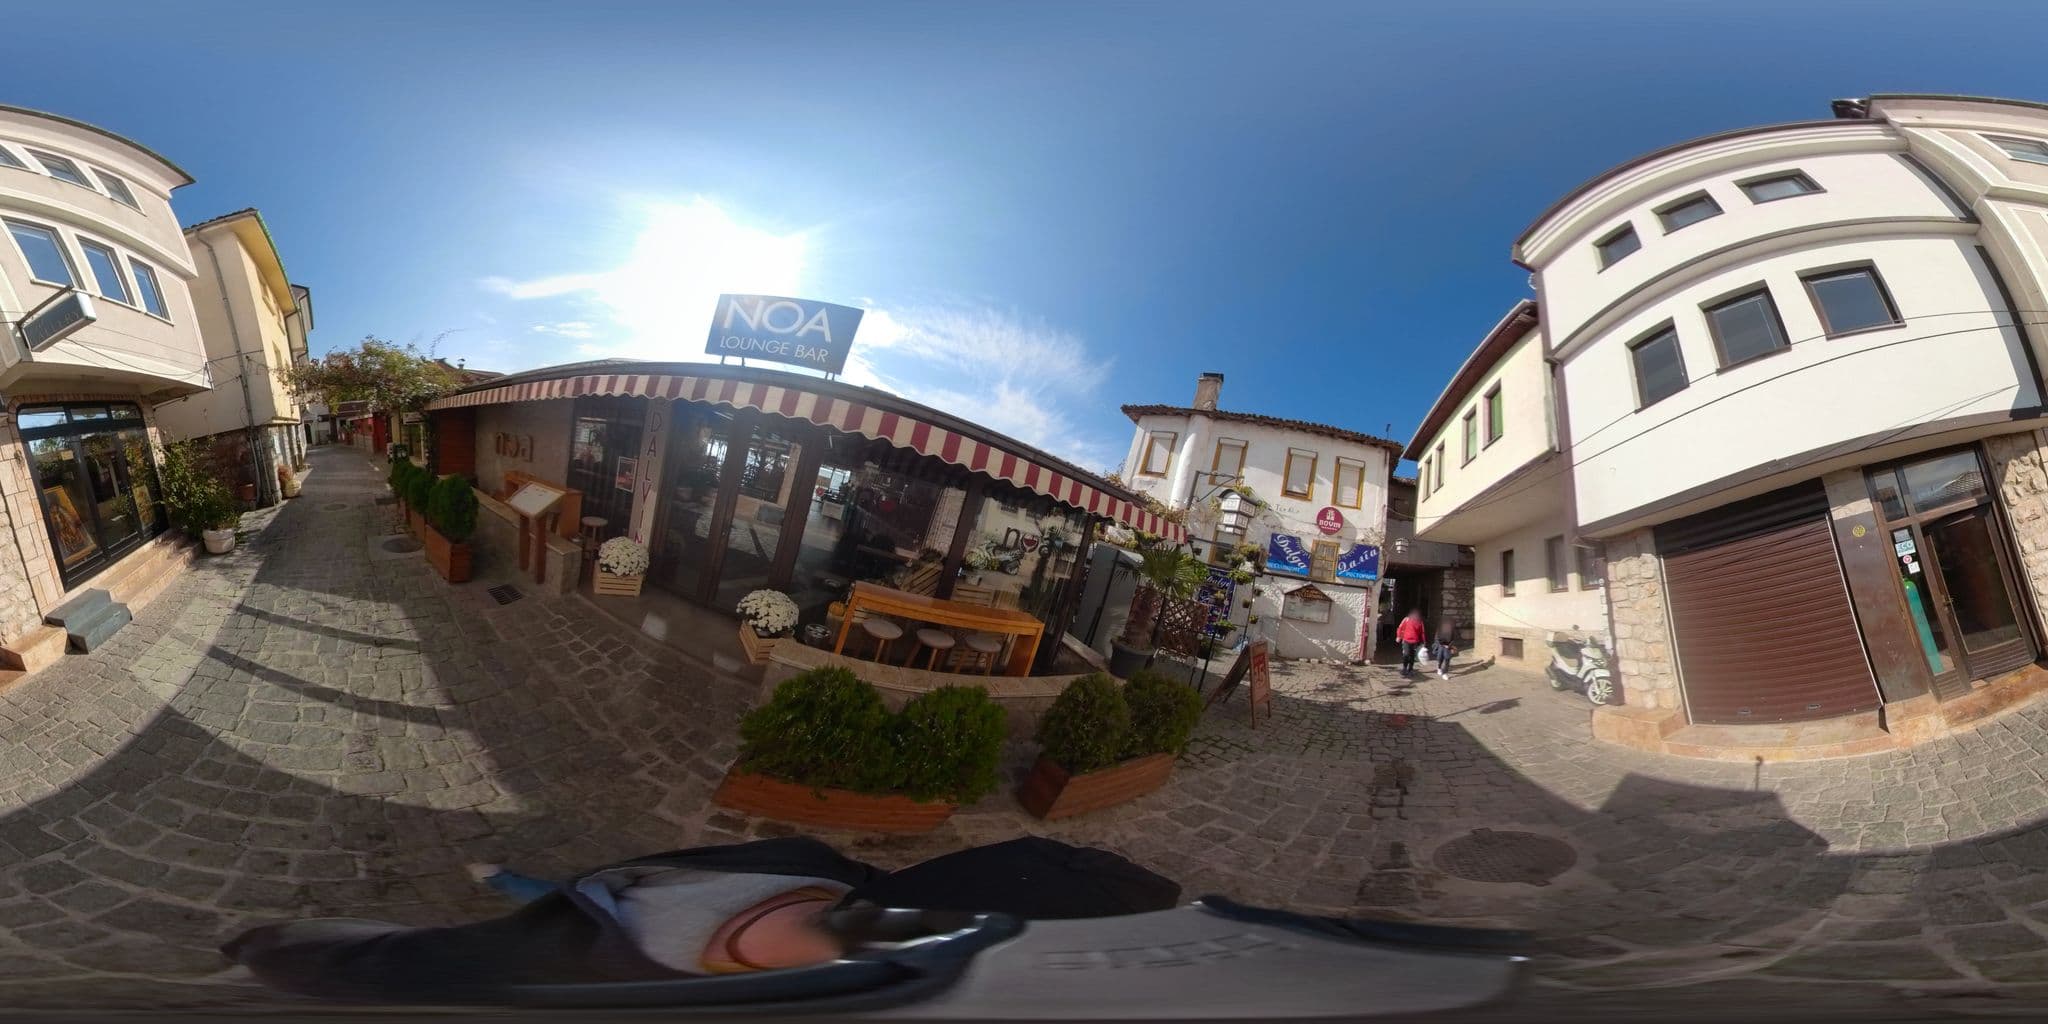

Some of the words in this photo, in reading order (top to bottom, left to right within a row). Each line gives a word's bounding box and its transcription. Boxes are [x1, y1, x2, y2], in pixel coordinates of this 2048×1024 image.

[723, 299, 832, 343] NOA
[720, 335, 790, 356] LOUNGE
[794, 344, 829, 363] BAR
[1273, 534, 1308, 569] Dalga
